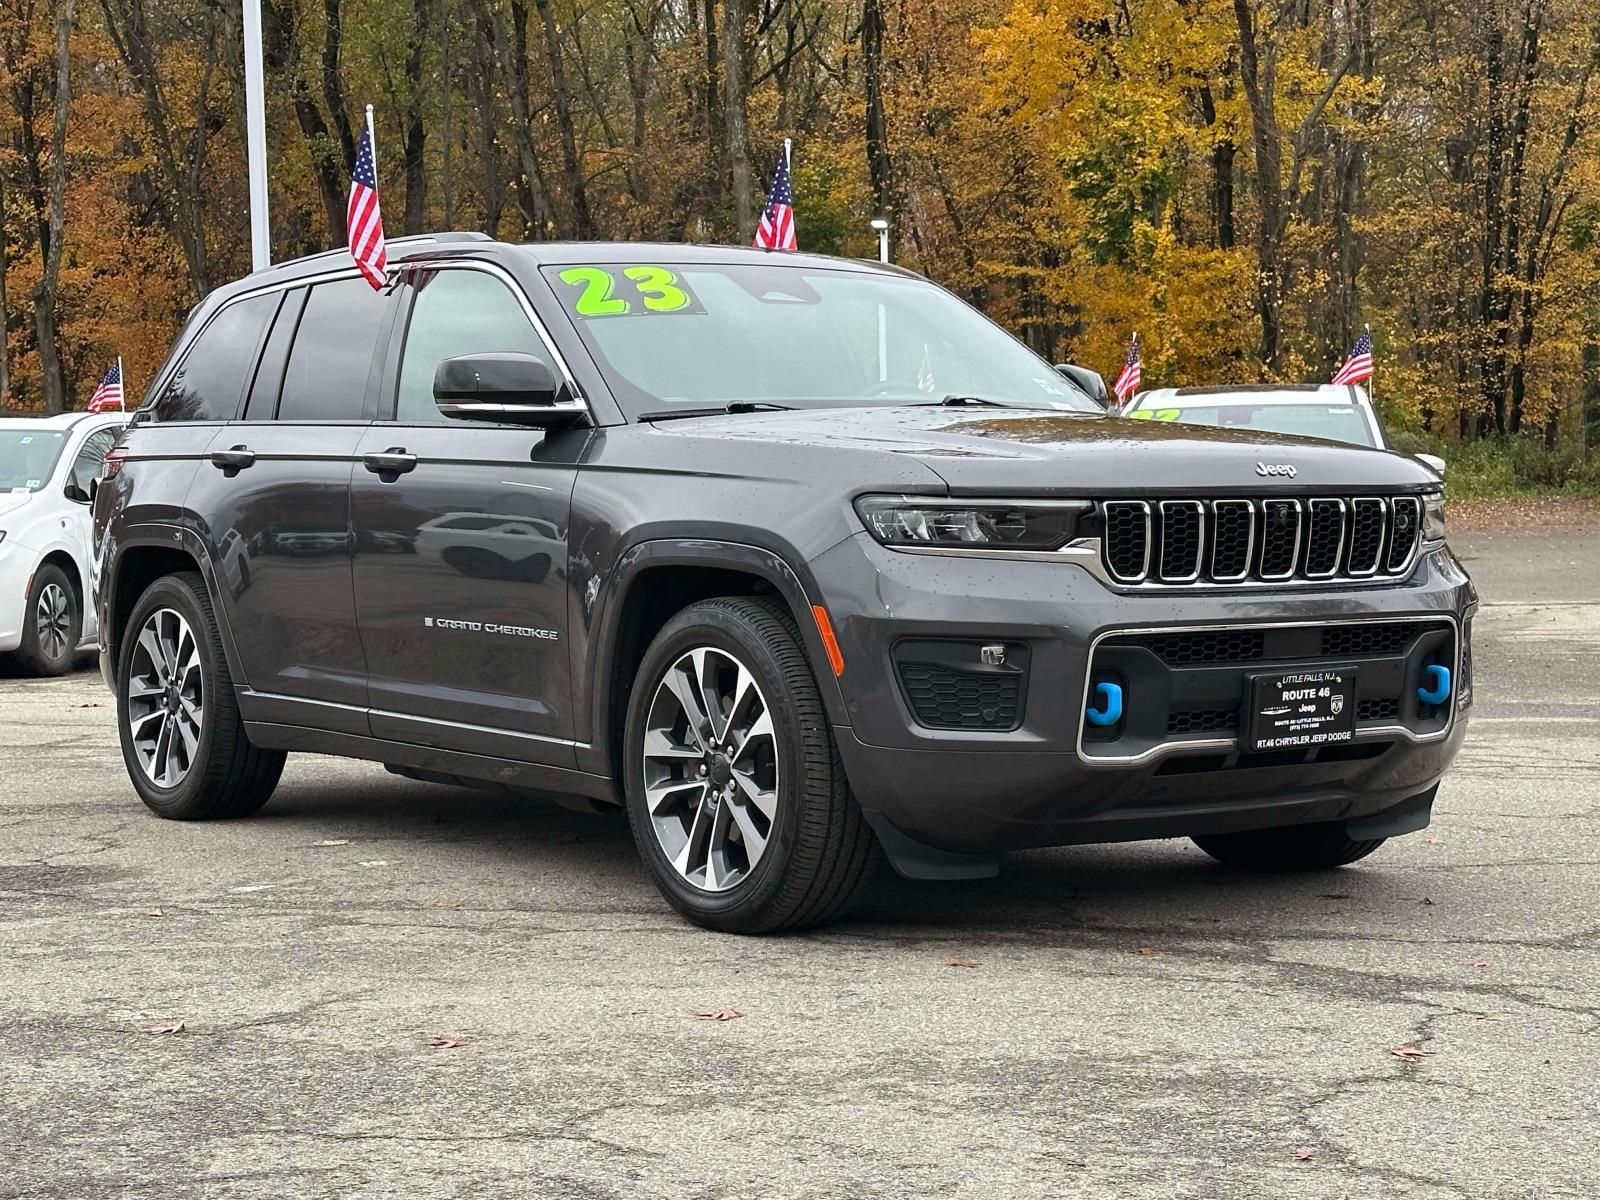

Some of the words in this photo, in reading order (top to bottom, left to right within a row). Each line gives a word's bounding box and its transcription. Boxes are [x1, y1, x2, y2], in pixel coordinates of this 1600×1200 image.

[559, 266, 691, 316] 23
[1255, 461, 1298, 479] Jeep
[436, 618, 482, 631] GRAND
[484, 623, 559, 640] CHEROKEE
[1282, 674, 1304, 684] LITTLE
[1282, 688, 1316, 701] ROUTE
[1318, 687, 1331, 698] 46
[1298, 703, 1316, 713] Jeep
[1275, 736, 1310, 747] CHRYSLER
[1310, 734, 1328, 743] JEEP
[1328, 731, 1352, 741] DODGE
